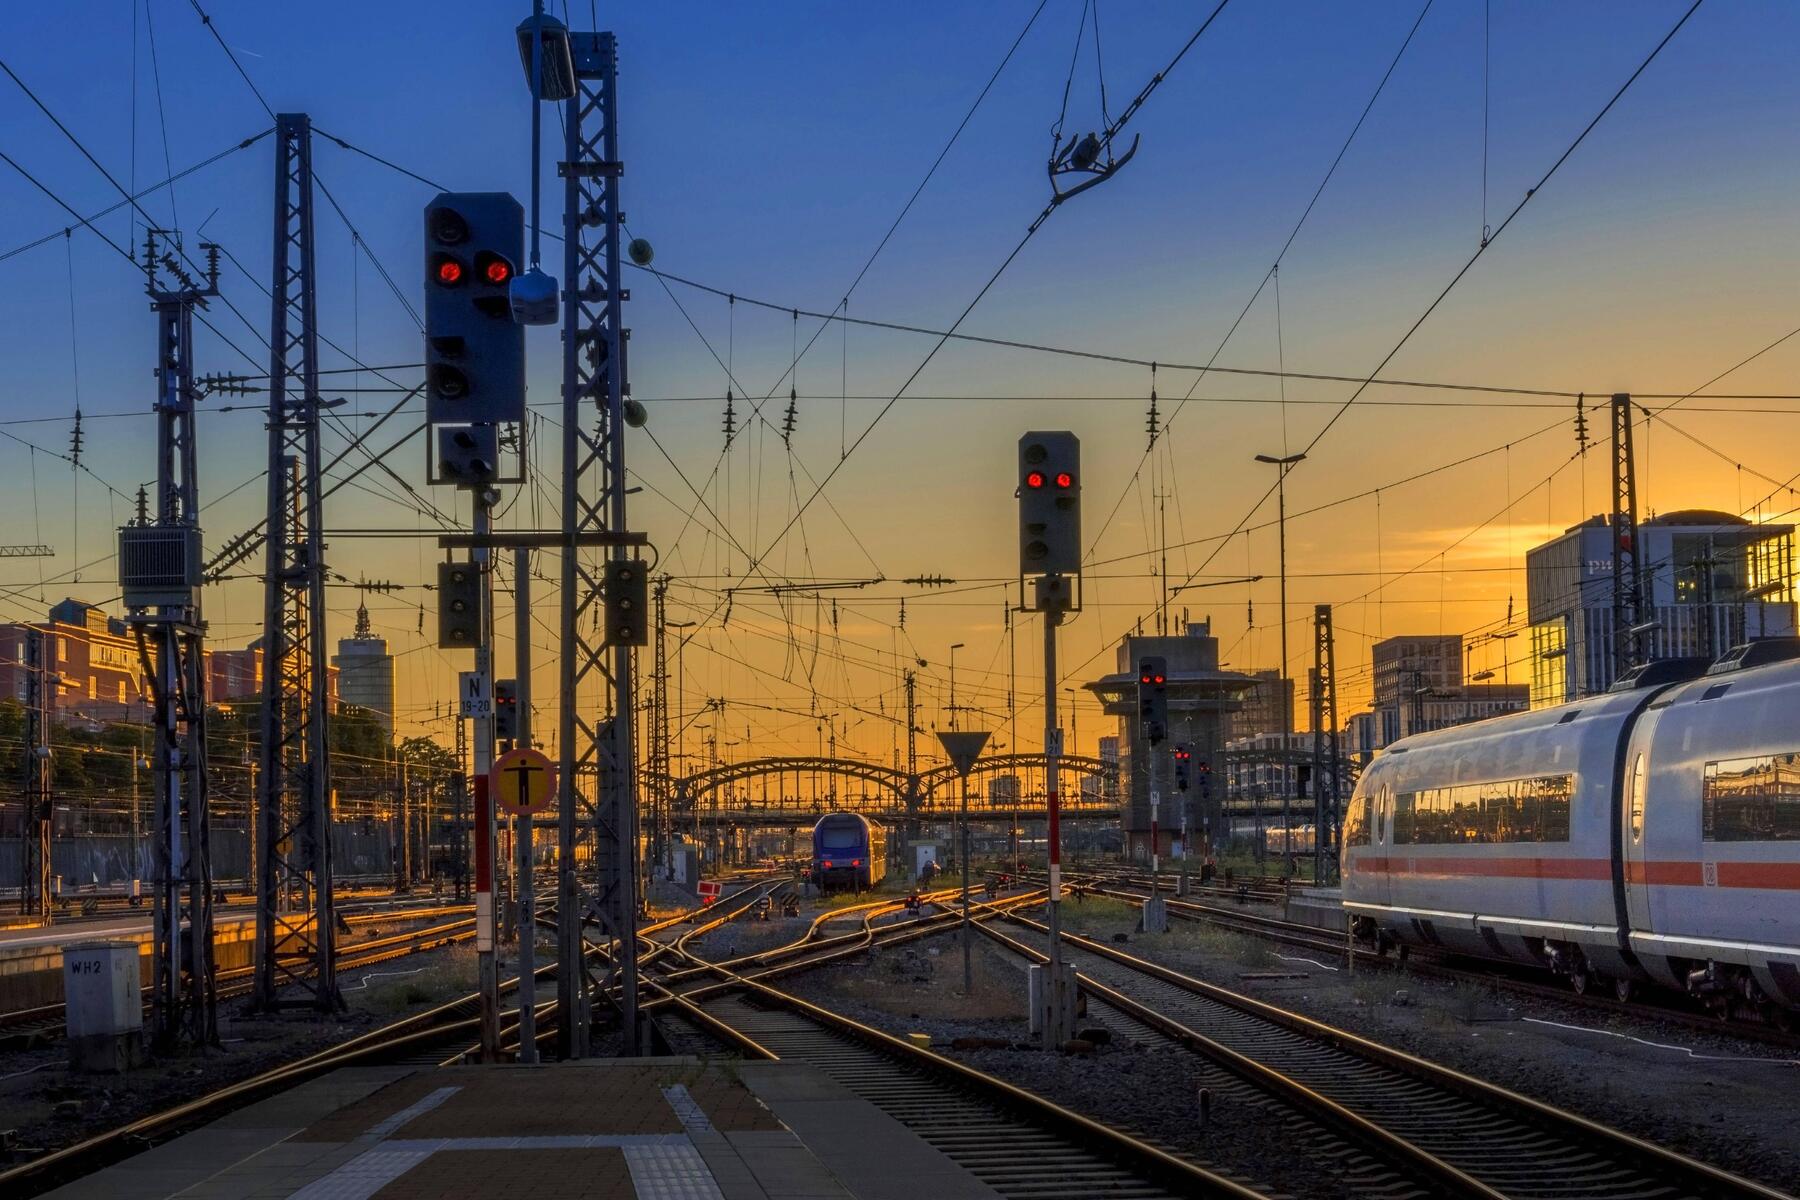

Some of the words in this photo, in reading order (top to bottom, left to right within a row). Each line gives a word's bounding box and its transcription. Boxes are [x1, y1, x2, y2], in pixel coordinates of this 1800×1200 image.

[1588, 560, 1615, 575] pw
[470, 678, 480, 697] N
[462, 700, 489, 712] 19-20
[1050, 732, 1059, 745] N
[72, 961, 101, 974] WH2
